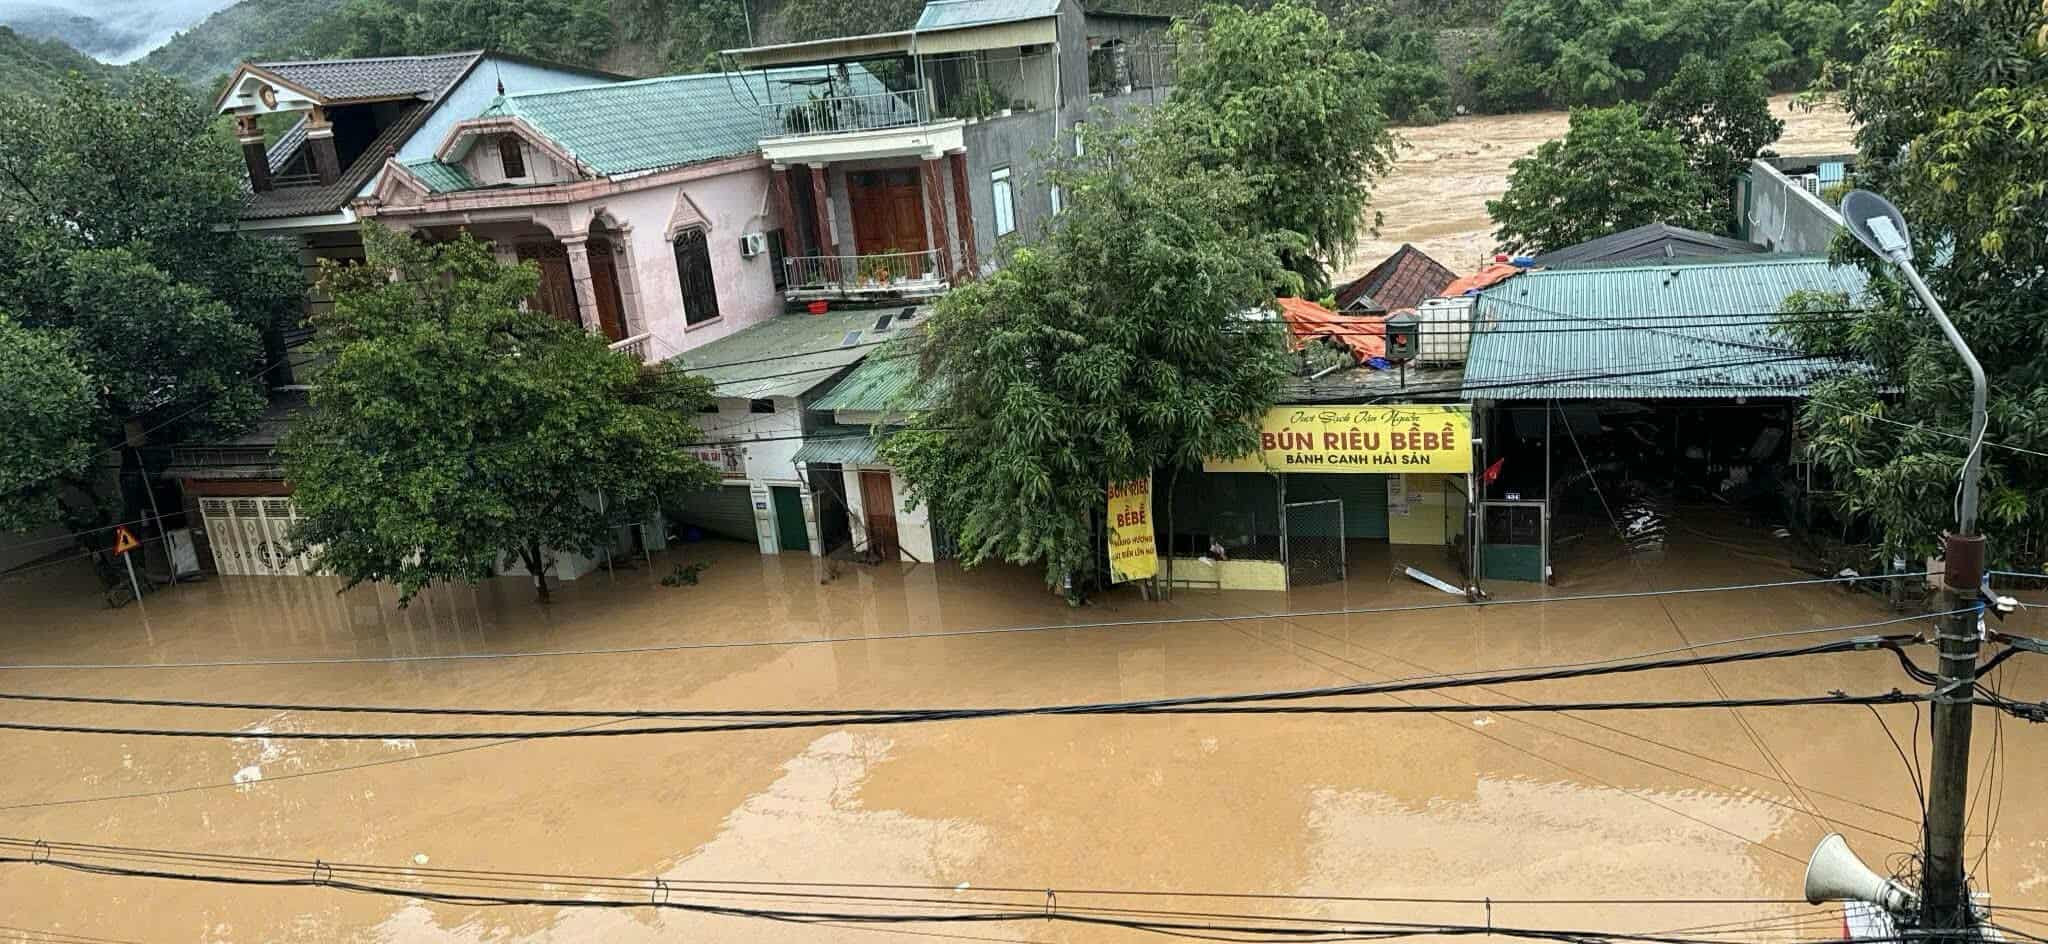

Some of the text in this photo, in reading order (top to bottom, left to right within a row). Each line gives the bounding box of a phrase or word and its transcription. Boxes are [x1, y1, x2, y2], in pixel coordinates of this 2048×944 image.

[1262, 422, 1455, 451] BÚN RIÊU BỀBỀ
[1286, 452, 1431, 464] BÁNH CANH HẢI SẢN
